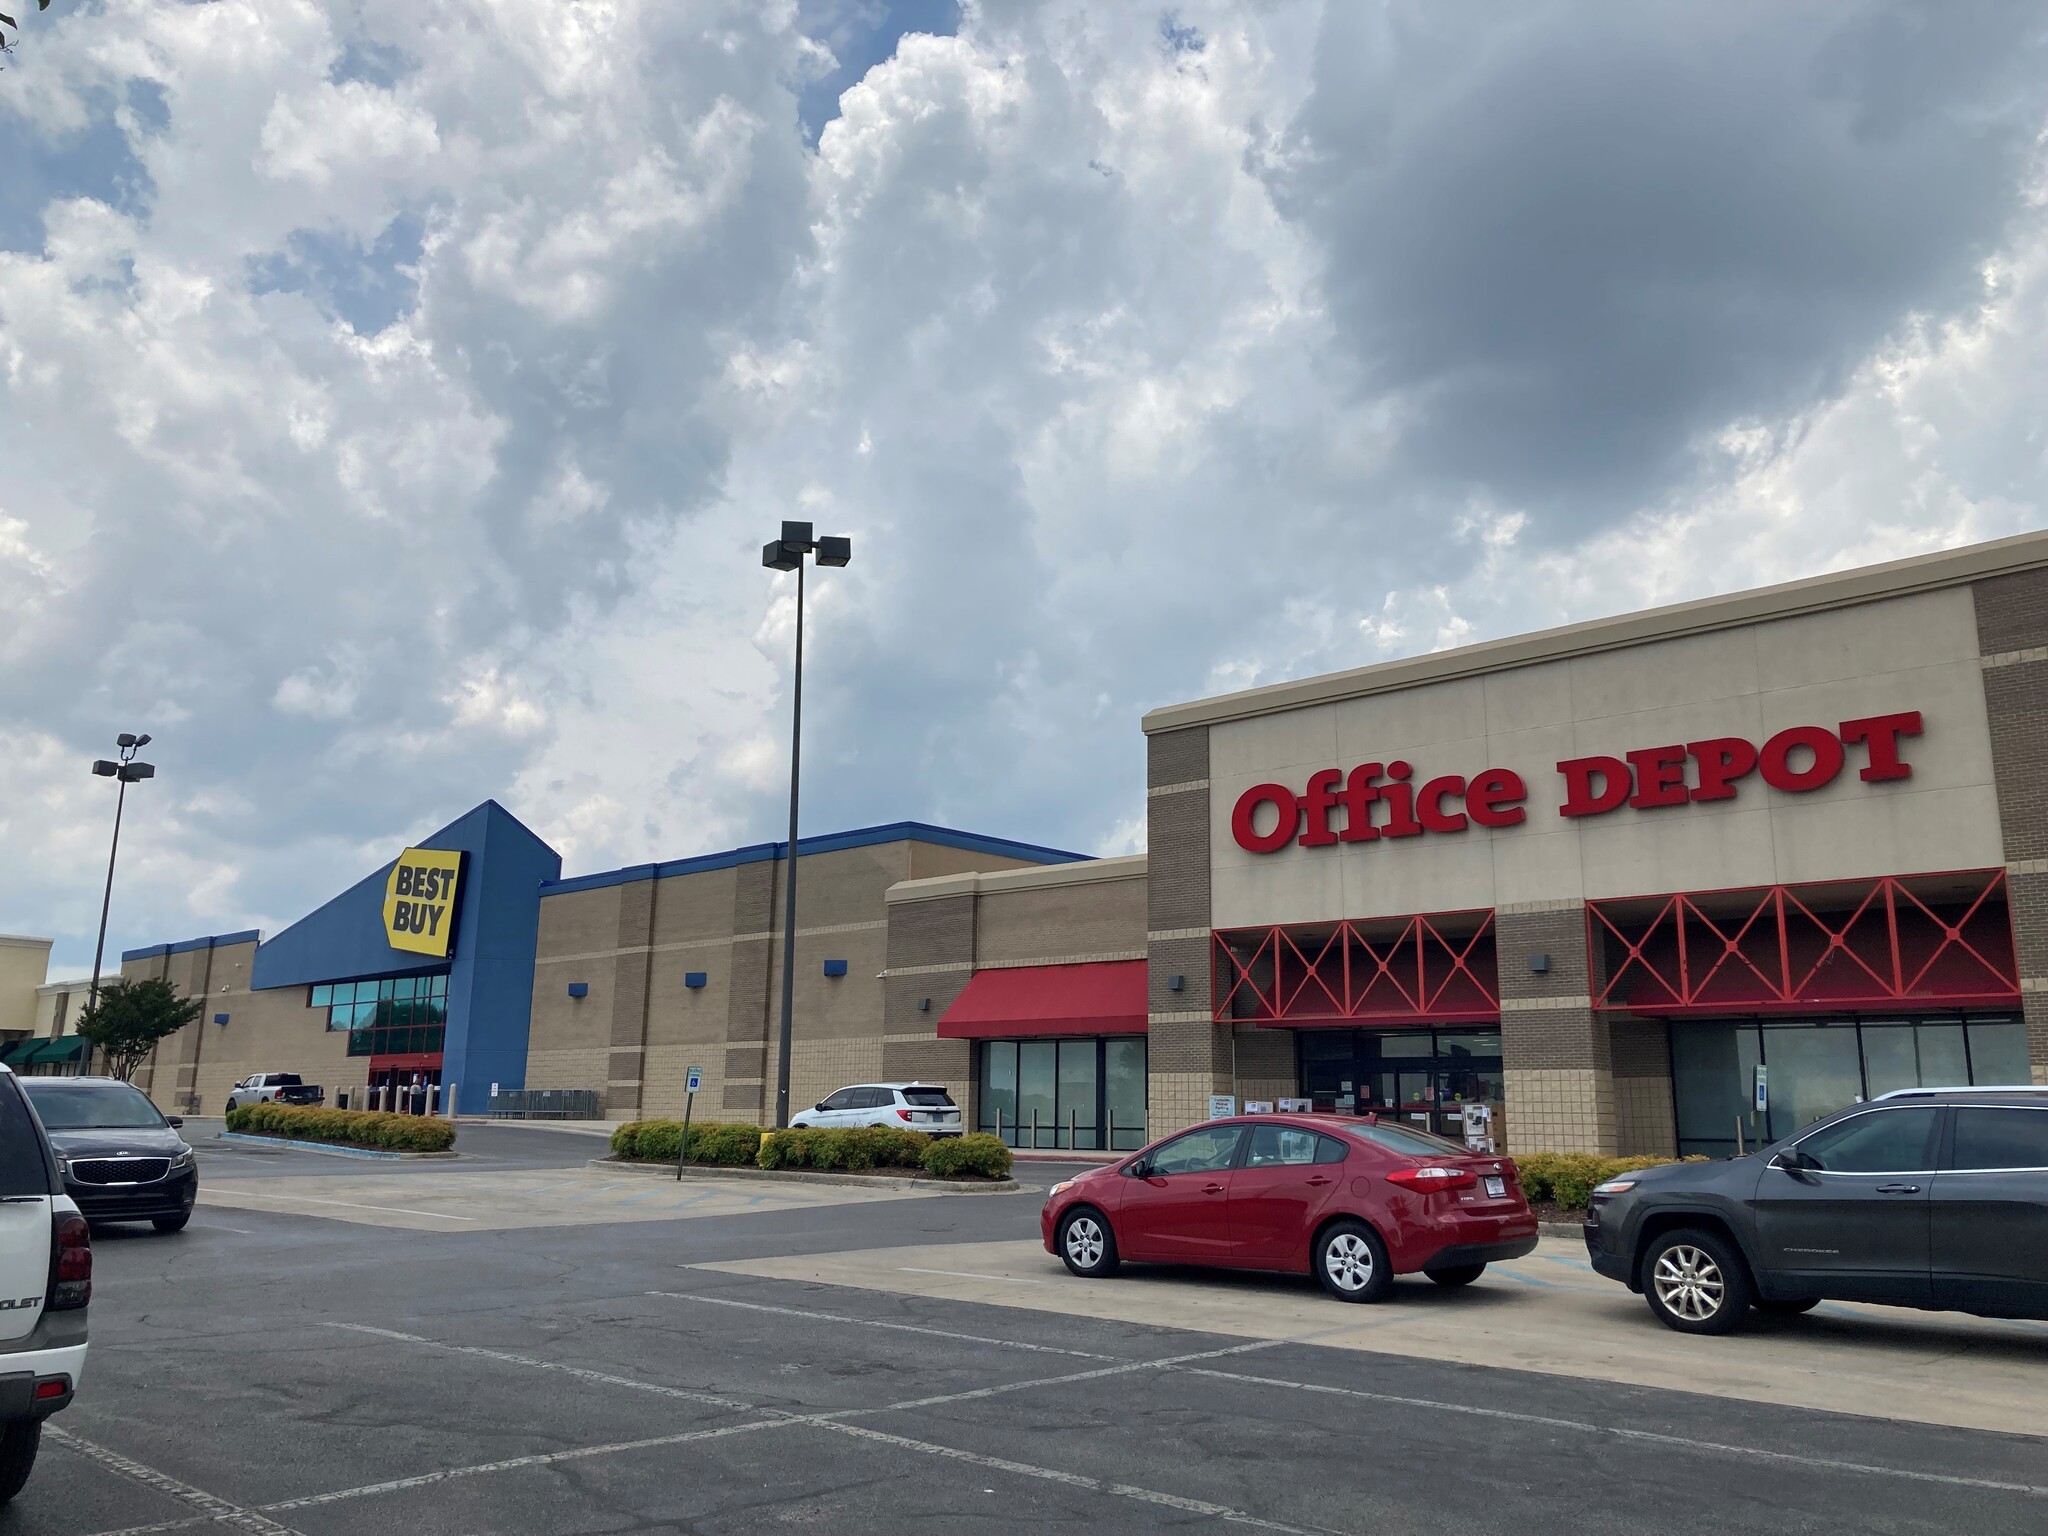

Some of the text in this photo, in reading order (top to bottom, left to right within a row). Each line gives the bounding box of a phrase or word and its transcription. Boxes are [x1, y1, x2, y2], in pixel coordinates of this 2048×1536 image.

[1231, 711, 1924, 853] Office DEPOT
[395, 865, 455, 901] BEST
[393, 900, 445, 937] BUY
